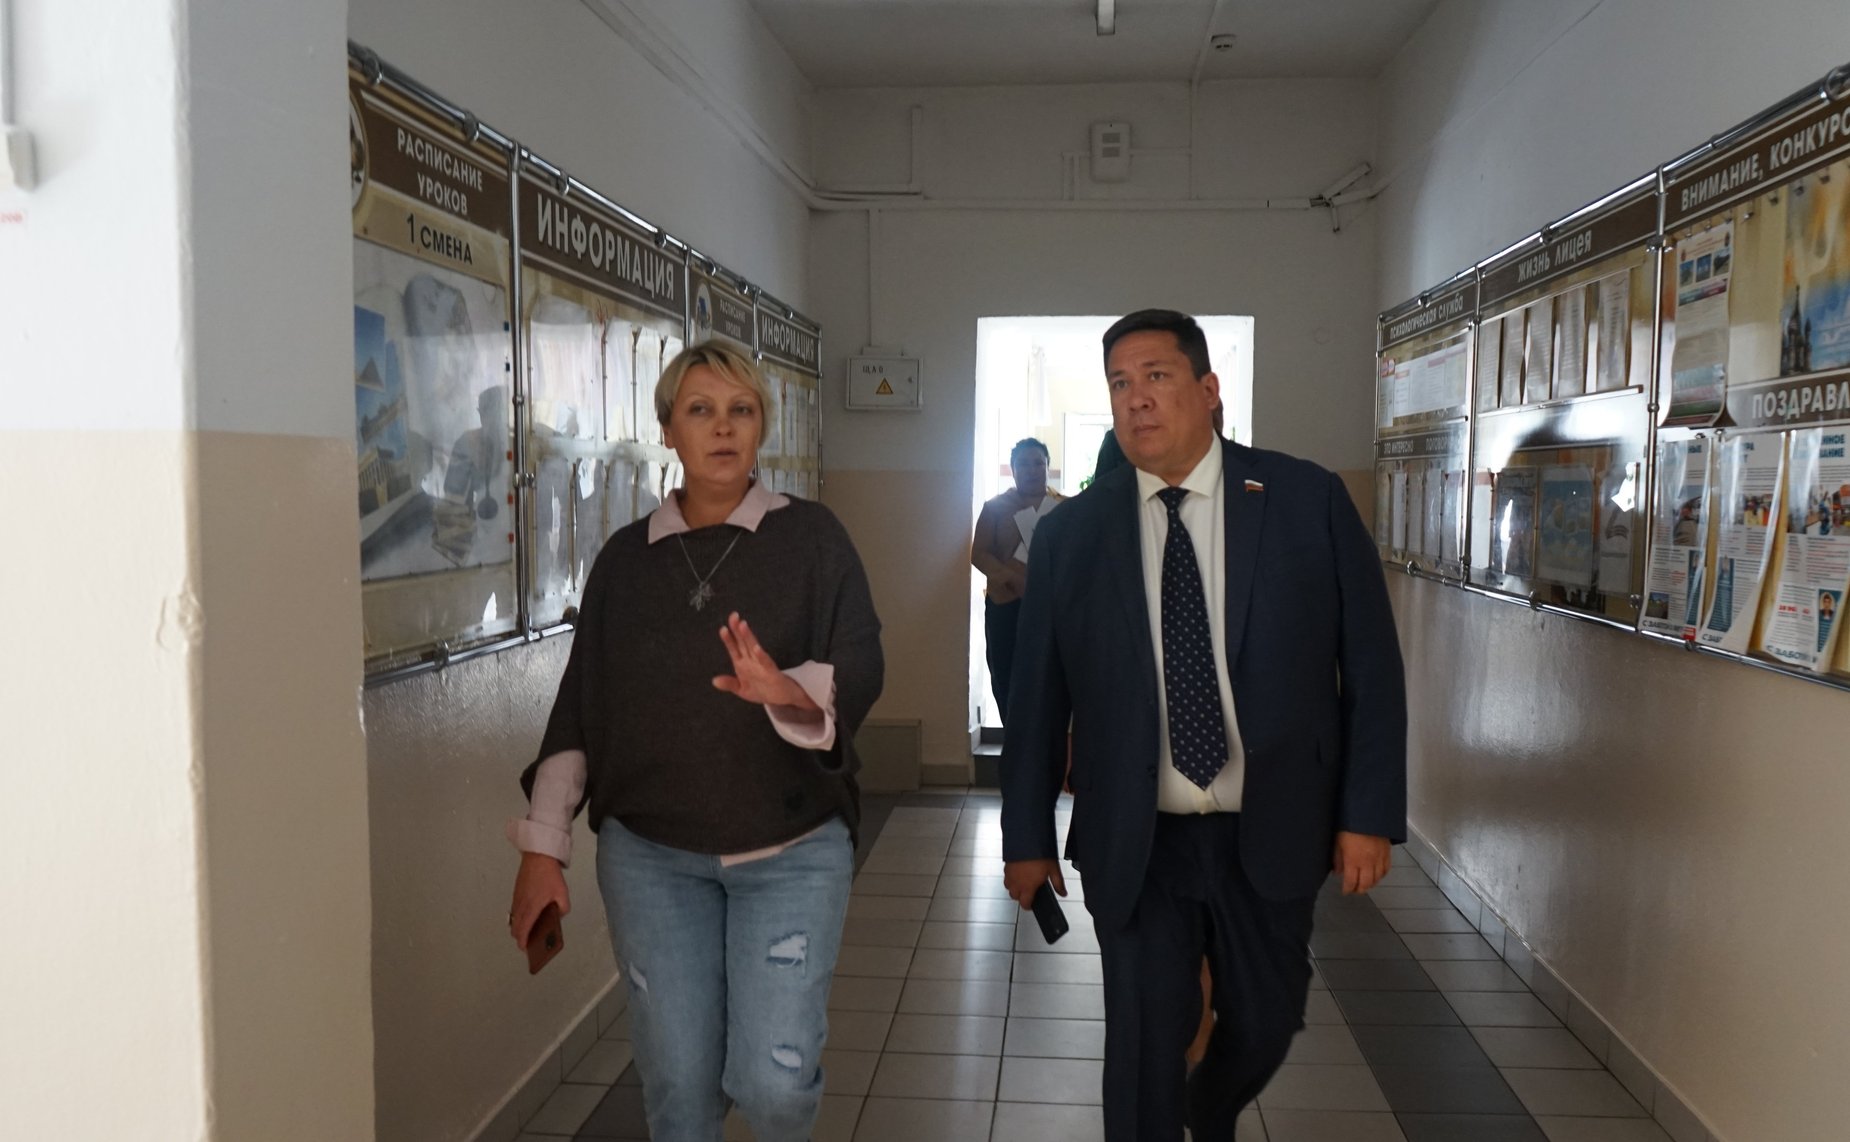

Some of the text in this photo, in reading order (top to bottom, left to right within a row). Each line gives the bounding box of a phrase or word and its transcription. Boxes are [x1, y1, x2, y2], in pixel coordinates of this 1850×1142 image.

[397, 127, 483, 193] РАСПИСАНИЕ
[1681, 153, 1764, 212] ВНИМАНИЕ,
[417, 172, 468, 216] УРОКОВ
[407, 213, 473, 265] 1 СМЕНА
[537, 192, 674, 300] ИНФОРМАЦИЯ
[761, 315, 815, 363] ИНФОРМАЦИЯ
[1752, 381, 1850, 420] ПОЗДРАВЛ
